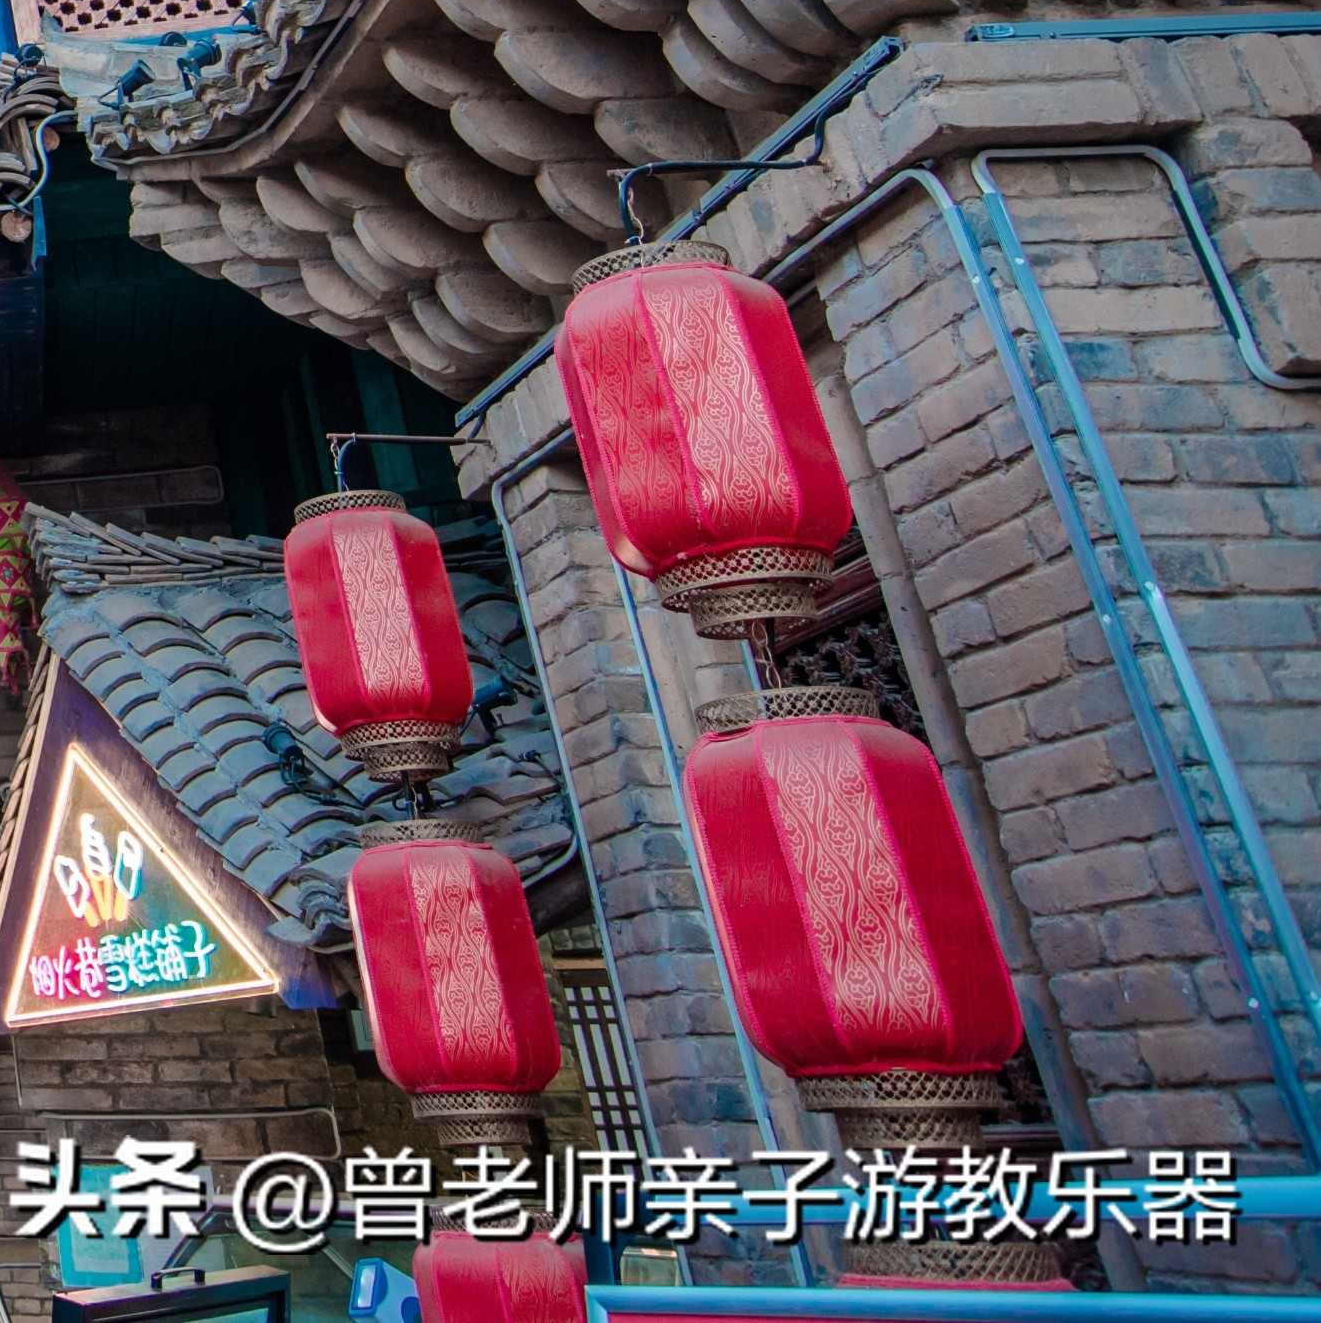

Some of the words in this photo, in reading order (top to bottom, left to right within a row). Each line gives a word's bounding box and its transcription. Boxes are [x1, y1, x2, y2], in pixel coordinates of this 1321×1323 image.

[29, 920, 217, 1000] 烟火巷雪糕铺子
